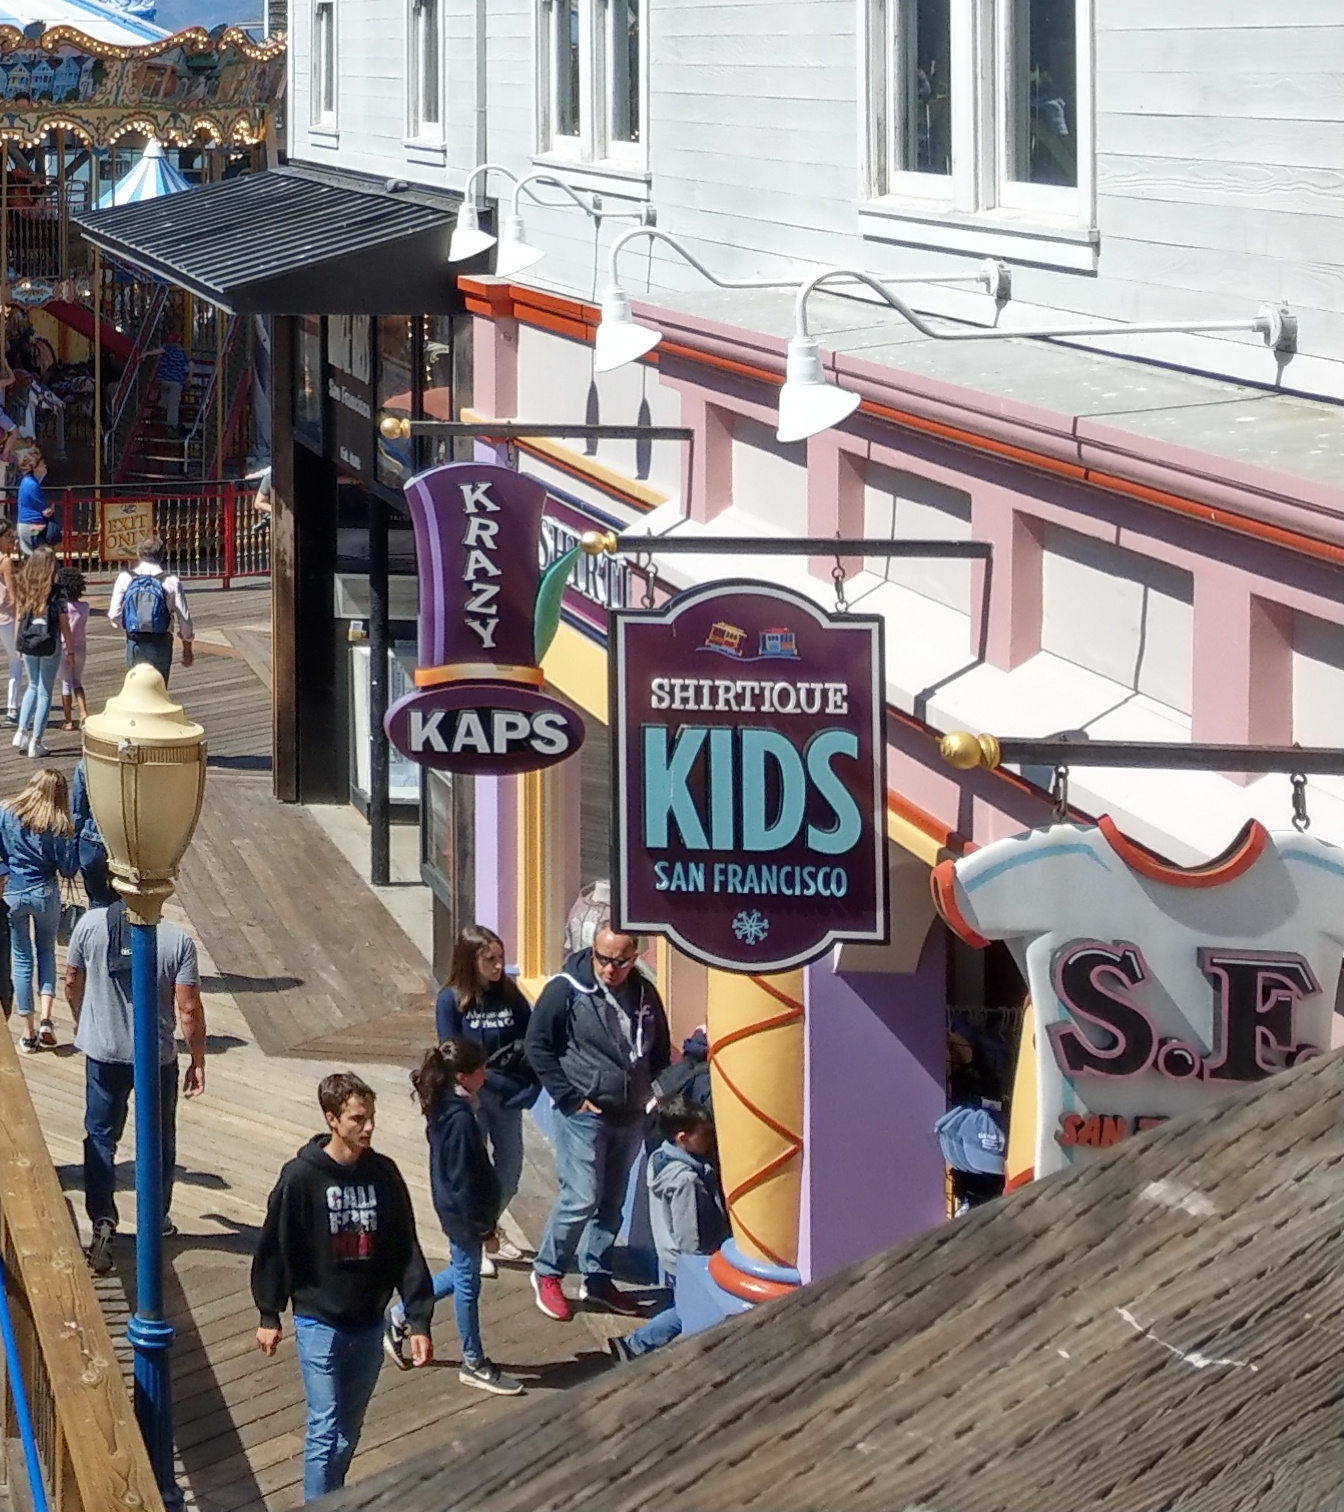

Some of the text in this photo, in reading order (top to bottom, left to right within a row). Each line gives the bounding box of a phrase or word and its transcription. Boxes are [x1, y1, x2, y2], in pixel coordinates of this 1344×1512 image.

[107, 513, 148, 534] EXIT
[459, 481, 502, 649] KRAZY
[650, 677, 848, 715] SHIRTIQUE
[409, 708, 569, 755] KAPS
[642, 724, 863, 856] KIDS
[655, 860, 848, 899] SAN FRANCISCO
[1055, 1113, 1127, 1148] SAN
[326, 1184, 377, 1211] CALI
